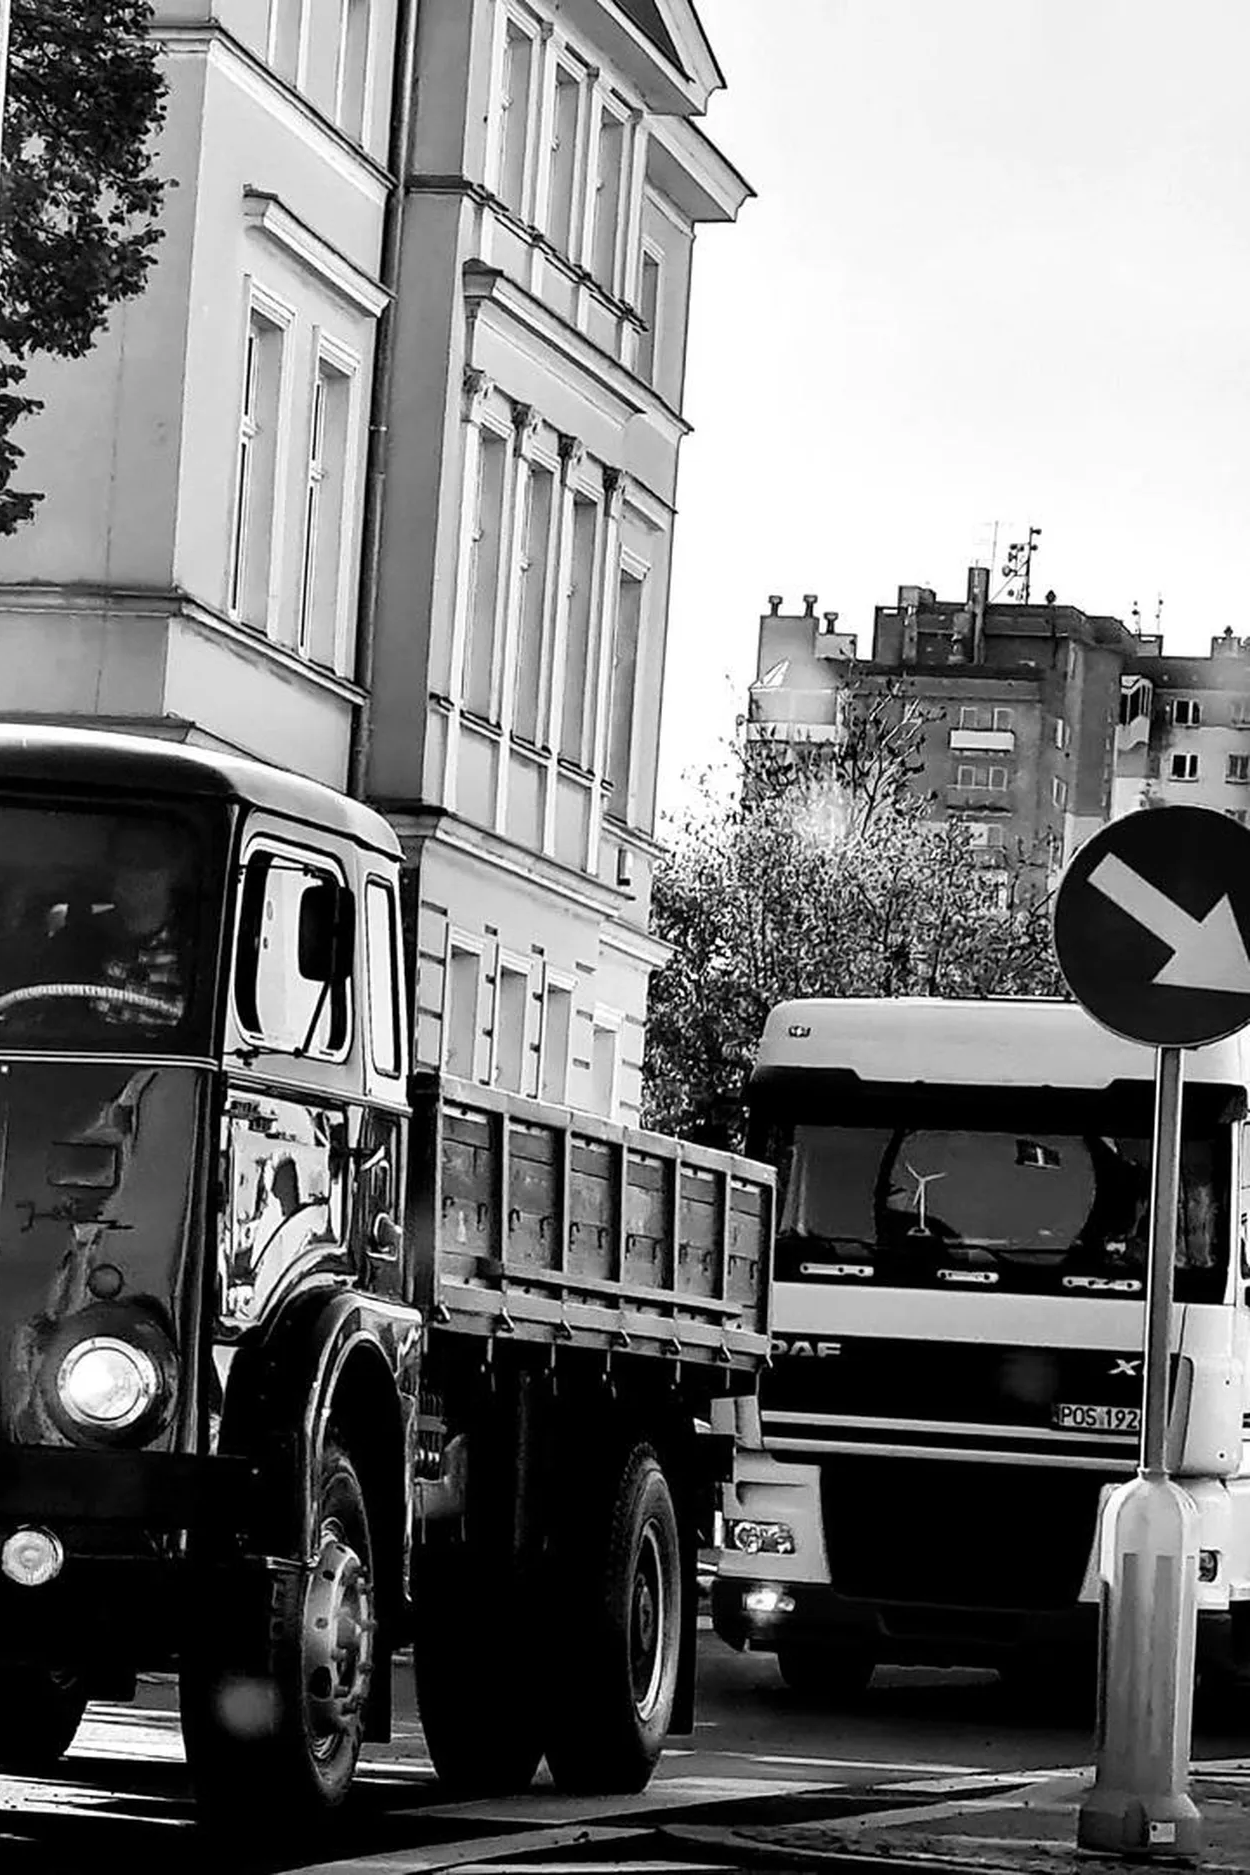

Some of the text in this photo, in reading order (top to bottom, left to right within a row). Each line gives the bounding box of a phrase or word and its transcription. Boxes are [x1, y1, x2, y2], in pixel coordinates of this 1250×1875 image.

[770, 1340, 841, 1357] DAF
[1107, 1359, 1143, 1375] X
[1061, 1406, 1139, 1430] POS 192
